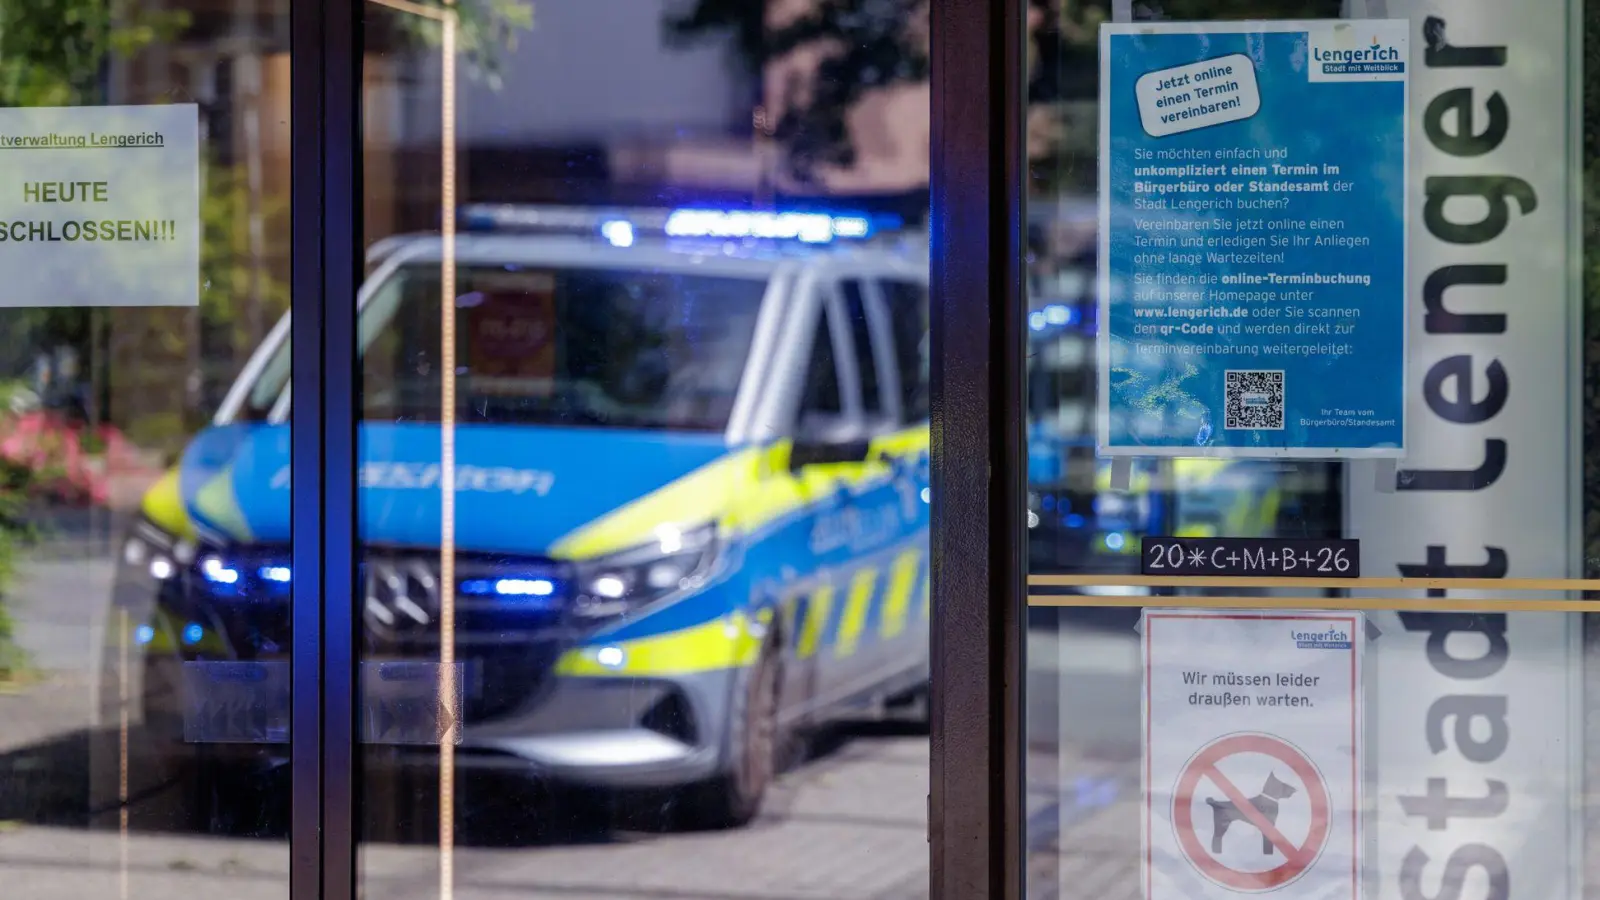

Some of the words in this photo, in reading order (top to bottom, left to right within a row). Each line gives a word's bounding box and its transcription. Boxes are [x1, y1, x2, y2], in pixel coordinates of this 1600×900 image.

[1314, 45, 1398, 63] Lengerich
[1324, 64, 1346, 72] Stadt
[1348, 64, 1361, 72] mit
[1364, 64, 1398, 72] Weitblick
[1156, 74, 1190, 92] Jetzt
[1194, 65, 1232, 83] online
[1156, 92, 1190, 108] einen
[1194, 81, 1239, 100] Termin
[1161, 97, 1241, 124] vereinbaren!
[91, 132, 163, 147] Lengerich
[1134, 149, 1153, 160] Sie
[1157, 148, 1211, 159] möchten
[1215, 148, 1260, 159] einfach
[1265, 147, 1287, 158] und
[1134, 164, 1226, 178] unkompliziert
[1232, 165, 1267, 175] einen
[1272, 164, 1317, 175] Termin
[1323, 164, 1339, 174] im
[24, 181, 108, 202] HEUTE
[1134, 181, 1210, 195] Bürgerbüro
[1215, 181, 1243, 192] oder
[1249, 181, 1329, 192] Standesamt
[1333, 181, 1353, 192] der
[1134, 198, 1167, 209] Stadt
[1171, 198, 1233, 212] Lengerich
[1238, 198, 1289, 209] buchen?
[1134, 219, 1209, 230] Vereinbaren
[1213, 219, 1232, 230] Sie
[1235, 219, 1263, 232] jetzt
[1268, 219, 1305, 230] online
[1310, 219, 1344, 229] einen
[1134, 236, 1176, 247] Termin
[1181, 236, 1204, 247] und
[1208, 235, 1265, 249] erledigen
[1270, 235, 1289, 246] Sie
[1293, 235, 1309, 246] Ihr
[1314, 235, 1369, 249] Anliegen
[1134, 253, 1164, 264] ohne
[1168, 252, 1202, 267] lange
[1206, 252, 1284, 264] Wartezeiten!
[1134, 273, 1153, 285] Sie
[1156, 273, 1195, 284] finden
[1199, 273, 1218, 284] die
[1222, 273, 1371, 286] online-Terminbuchung
[1134, 290, 1156, 301] auf
[1160, 290, 1205, 301] unserer
[1210, 290, 1275, 303] Homepage
[1280, 290, 1313, 301] unter
[1134, 307, 1248, 320] www.lengerich.de
[1252, 307, 1281, 317] oder
[1285, 307, 1304, 317] Sie
[1308, 308, 1360, 317] scannen
[1134, 323, 1156, 334] den
[1160, 323, 1213, 336] qr-Code
[1218, 323, 1240, 334] und
[1245, 323, 1290, 334] werden
[1294, 323, 1330, 334] direkt
[1335, 324, 1354, 334] zur
[1135, 344, 1258, 357] Terminvereinbarung
[1263, 344, 1353, 357] weitergeleitet:
[1300, 418, 1395, 427] Bürgerbüro/Standesamt
[1291, 629, 1347, 642] Lengerich
[1183, 672, 1207, 685] Wir
[1213, 673, 1271, 686] müssen
[1276, 674, 1320, 687] leider
[1189, 693, 1250, 708] draußen
[1257, 694, 1313, 707] warten.
[1396, 546, 1512, 900] Stadt
